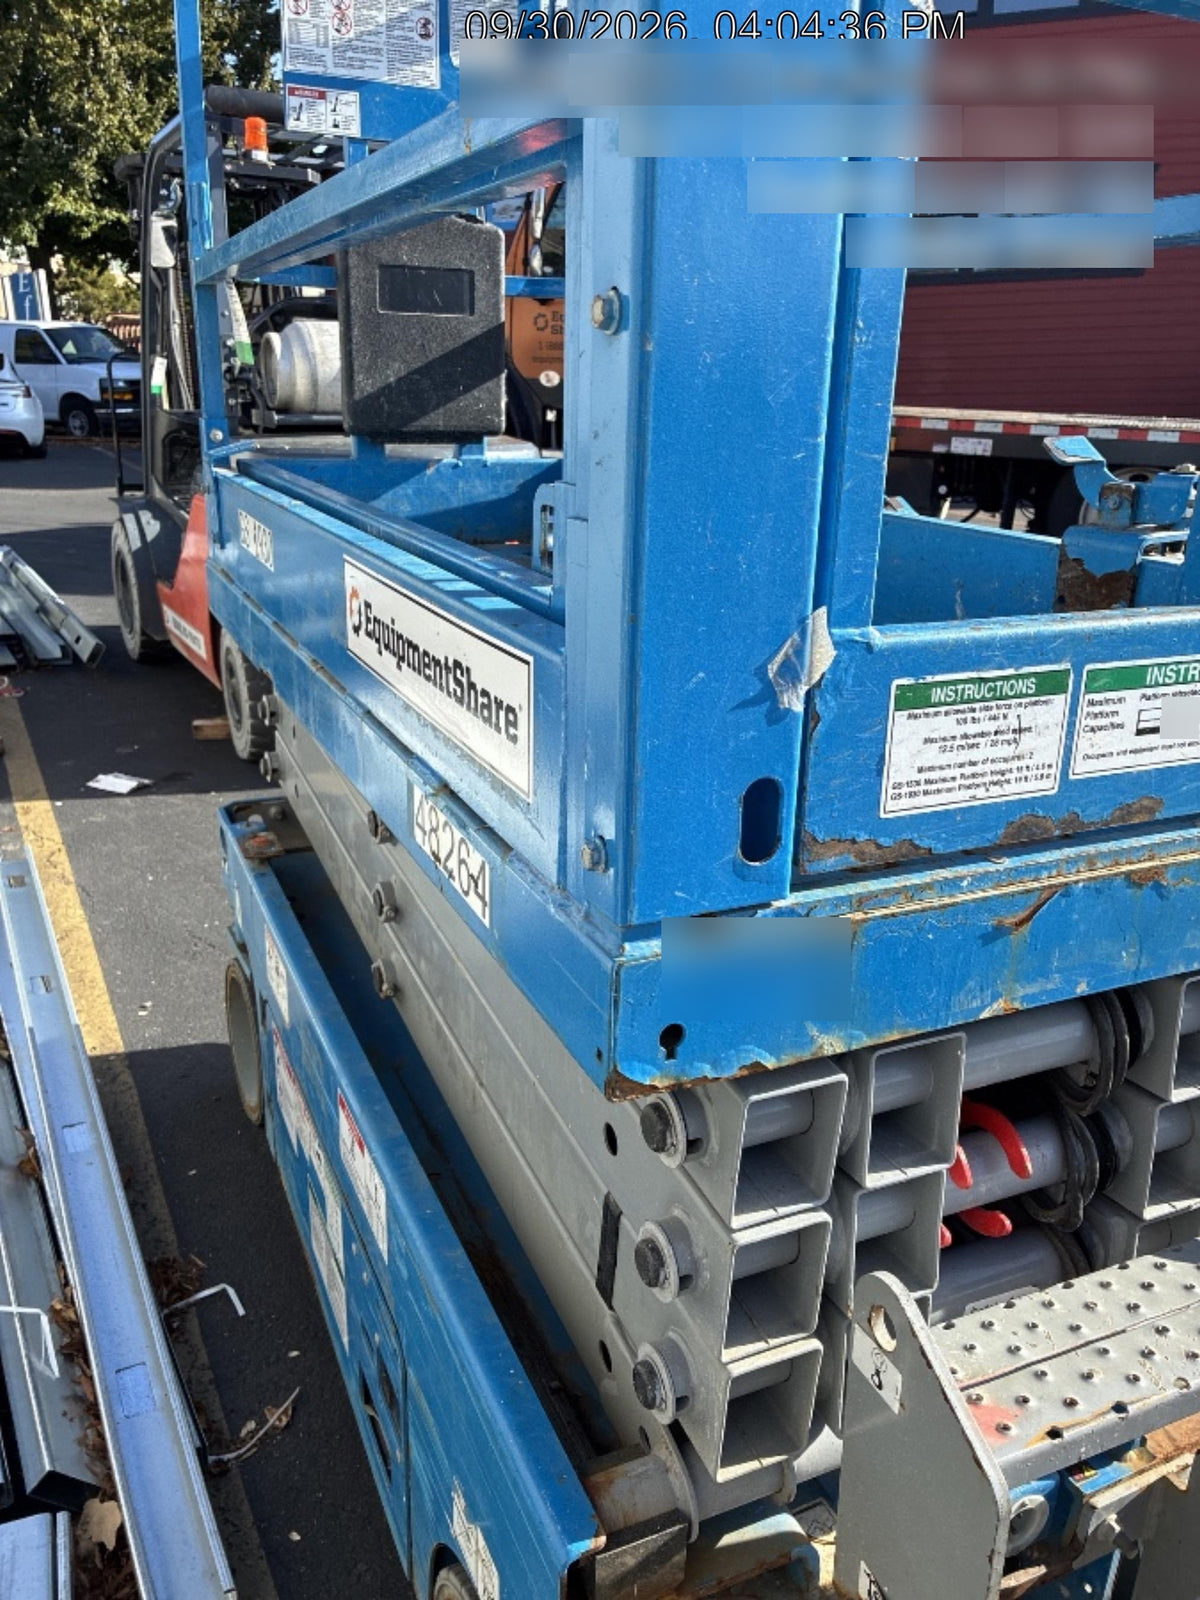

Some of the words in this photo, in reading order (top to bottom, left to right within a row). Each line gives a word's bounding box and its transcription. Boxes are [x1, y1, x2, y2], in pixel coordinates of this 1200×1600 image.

[364, 600, 518, 745] EquipmentShare
[931, 678, 1037, 703] INSTRUCTIONS
[415, 794, 488, 920] 48264
